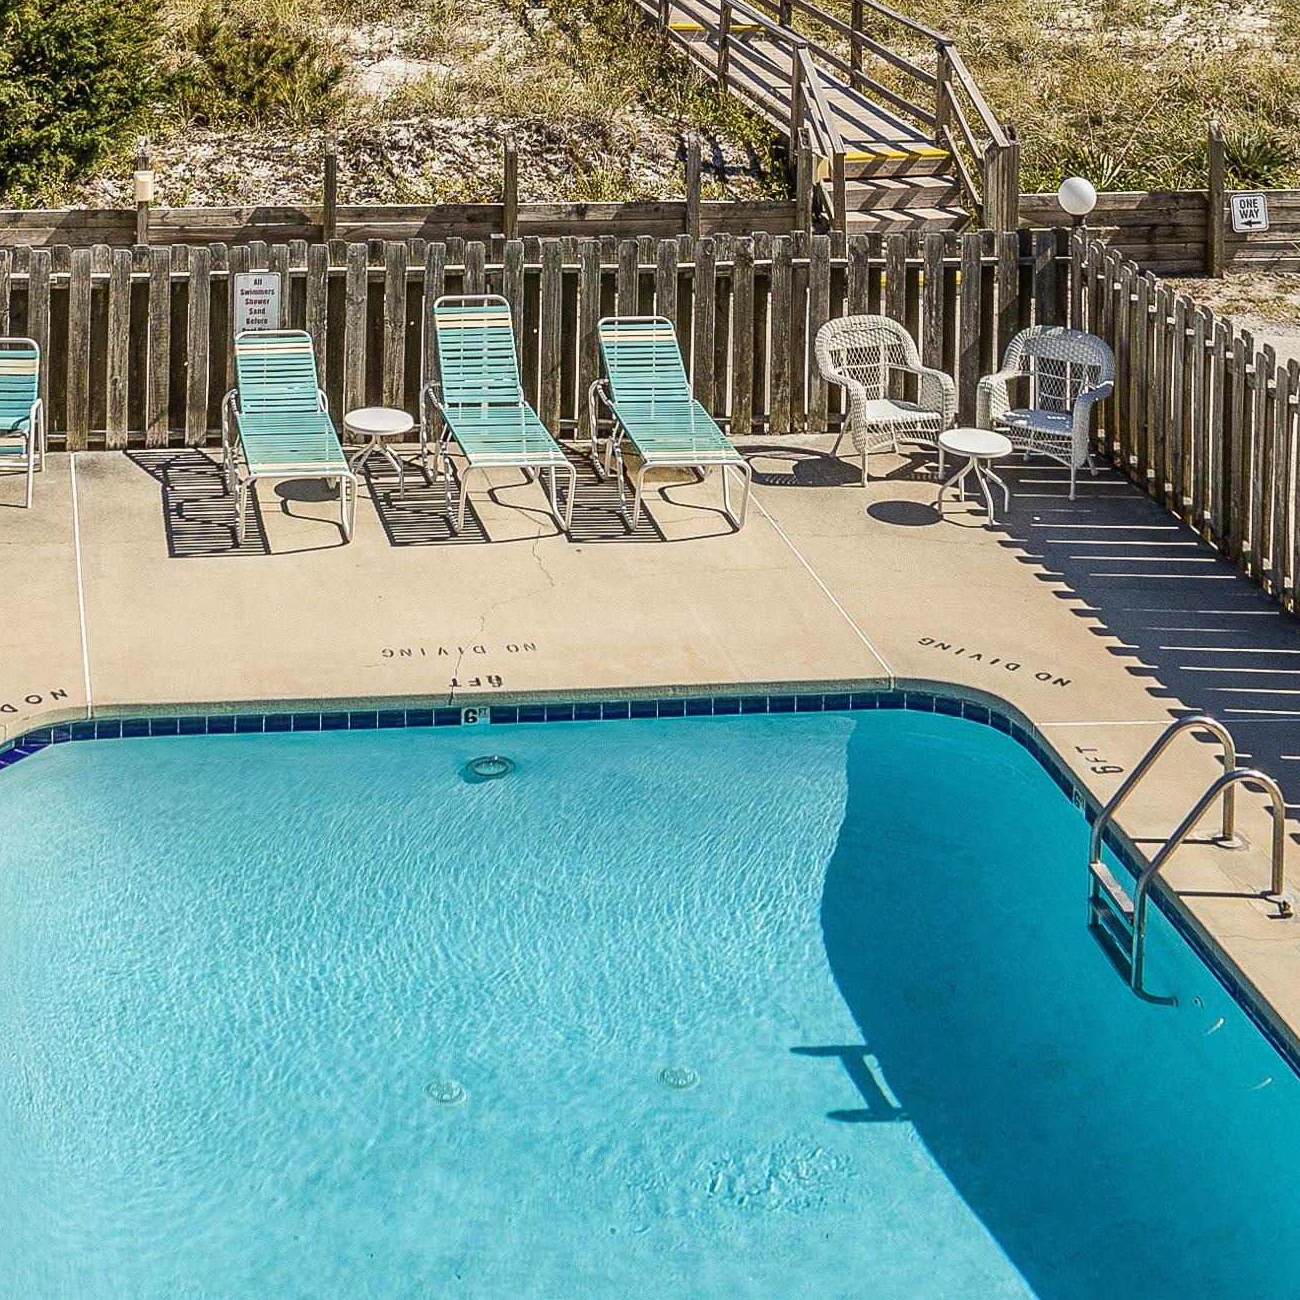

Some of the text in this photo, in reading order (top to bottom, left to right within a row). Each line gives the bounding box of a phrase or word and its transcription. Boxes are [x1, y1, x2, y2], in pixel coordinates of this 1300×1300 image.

[1239, 199, 1259, 209] ONE
[1239, 209, 1260, 219] WAY
[249, 307, 266, 315] Sand
[246, 317, 269, 325] Before
[381, 642, 538, 658] NO DIVING
[918, 637, 1072, 687] NO DIVING
[25, 689, 68, 704] NO
